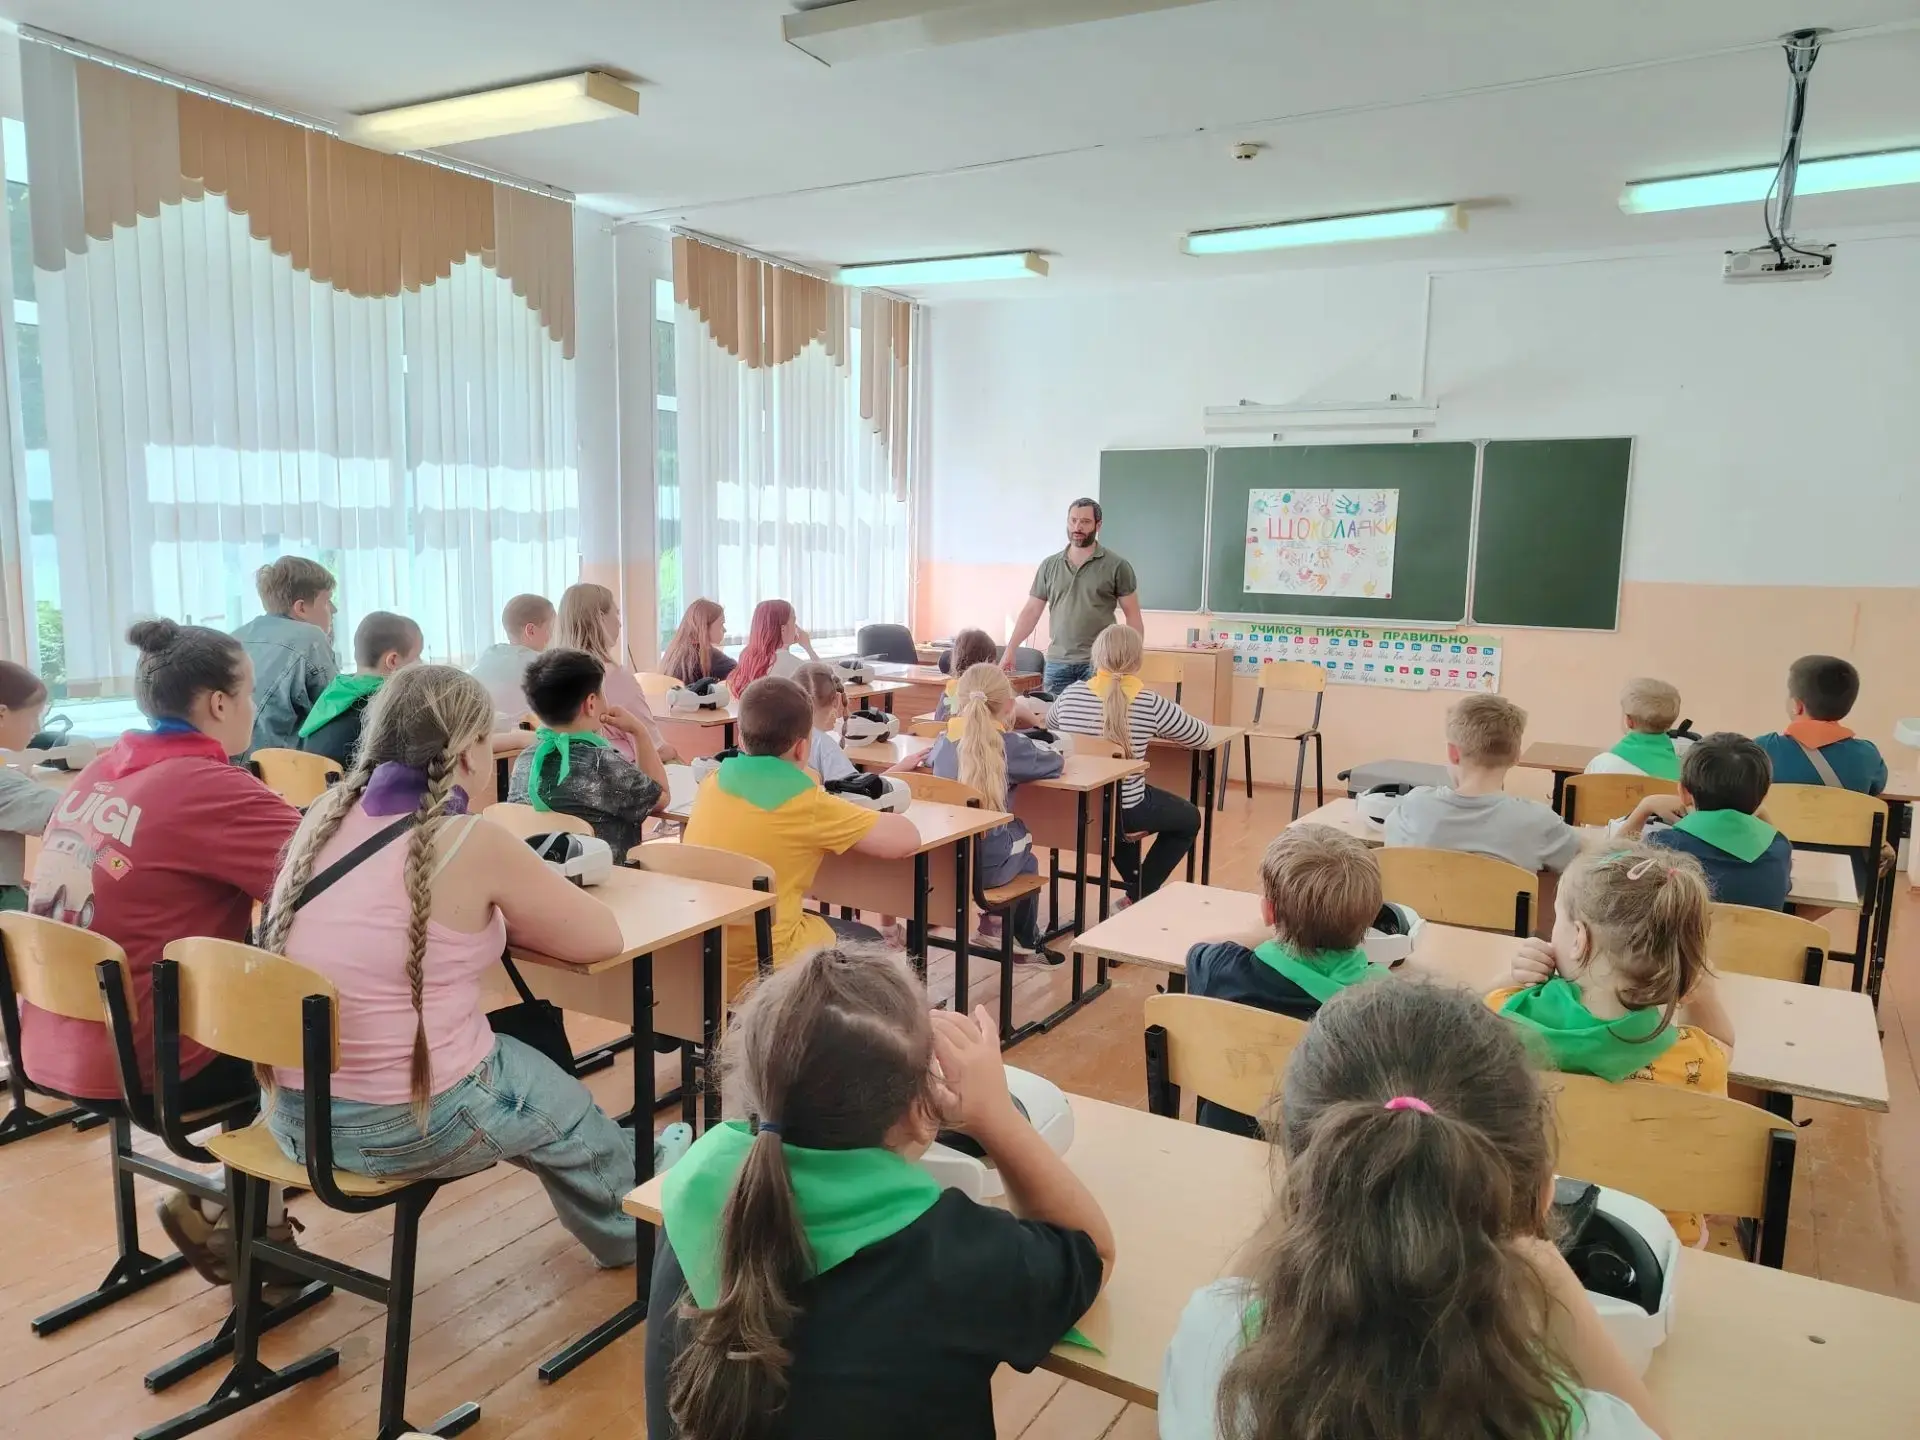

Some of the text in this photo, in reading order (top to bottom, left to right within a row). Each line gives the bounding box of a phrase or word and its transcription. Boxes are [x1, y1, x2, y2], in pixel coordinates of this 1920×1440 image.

[1250, 624, 1302, 635] УЧИМСЯ
[1316, 627, 1370, 639] ПИСАТЬ
[1382, 631, 1469, 644] ПРАВИЛЬНО
